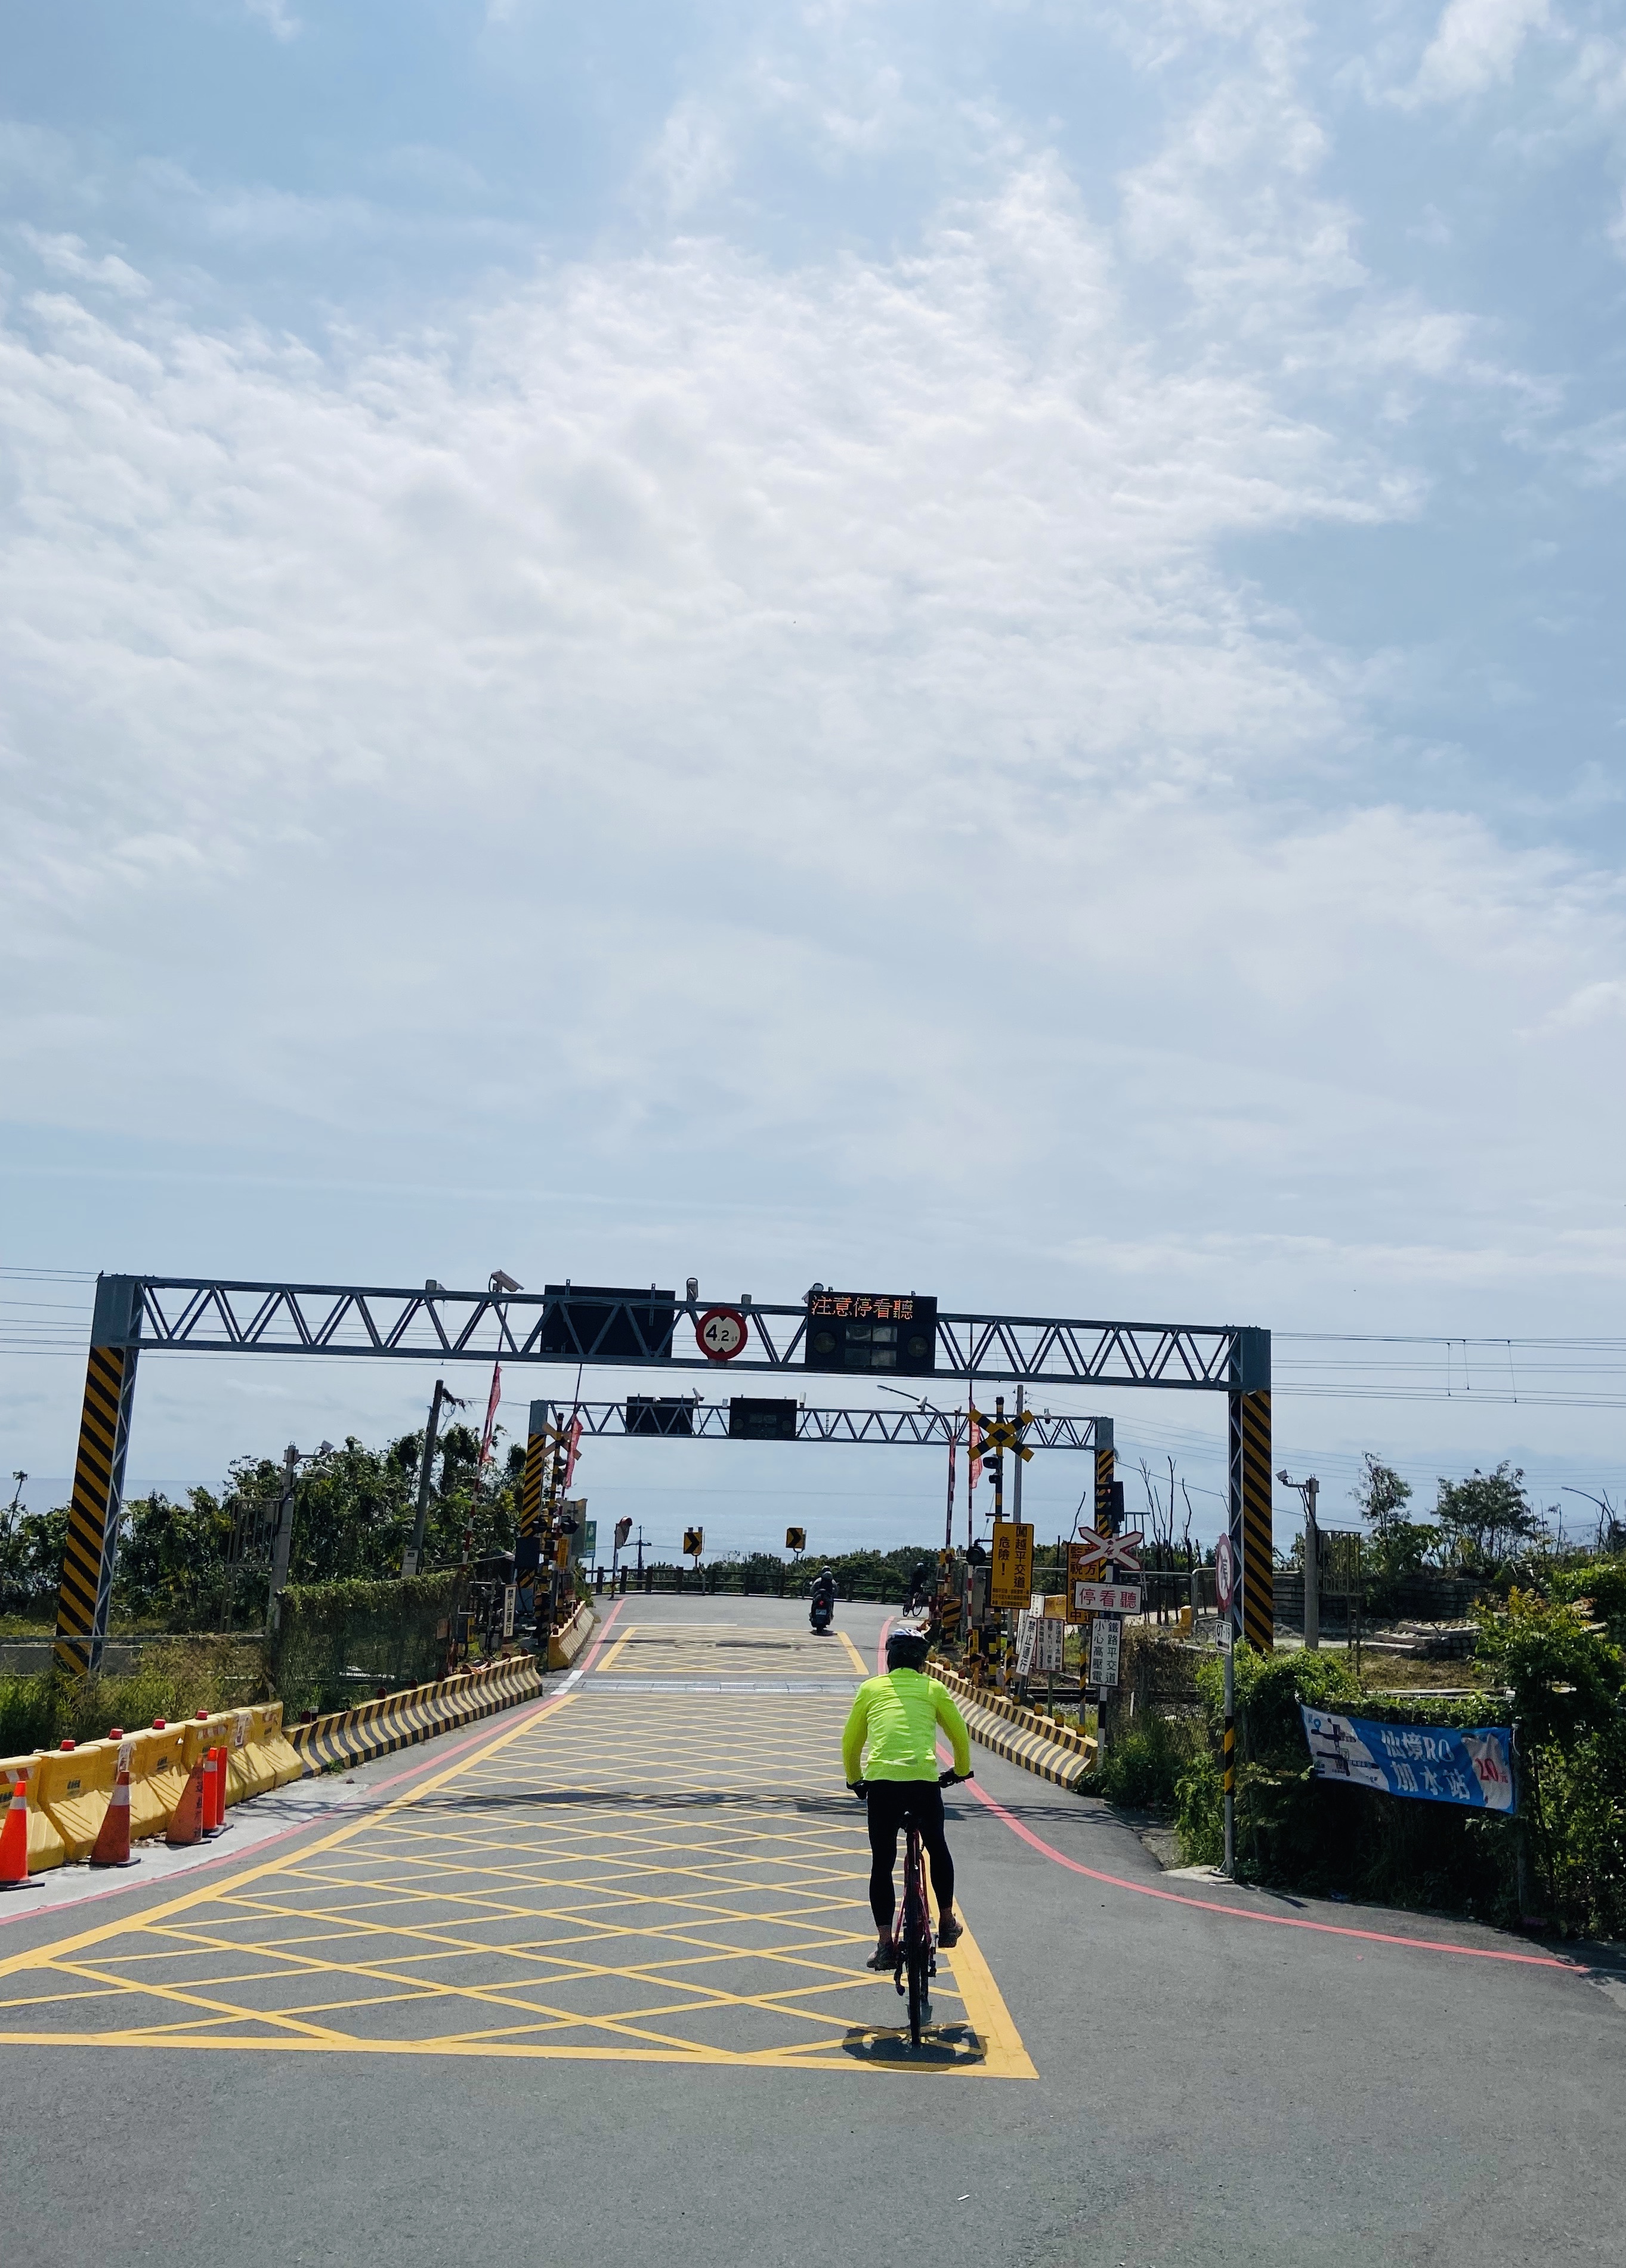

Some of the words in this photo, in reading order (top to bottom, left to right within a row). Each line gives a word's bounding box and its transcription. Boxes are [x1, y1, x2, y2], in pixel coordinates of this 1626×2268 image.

[811, 1295, 913, 1320] 注意停看聽
[706, 1324, 729, 1341] 4.2
[998, 1535, 1010, 1576] 危險!
[1013, 1526, 1028, 1589] 闖越平交道
[1079, 1587, 1137, 1609] 停看聽
[1019, 1620, 1036, 1672] 禁止通行
[1092, 1620, 1105, 1684] 小心高壓電
[1105, 1622, 1118, 1684] 鐵路平交道
[1380, 1729, 1455, 1763] 仙境RO
[1390, 1760, 1470, 1800] 加水站
